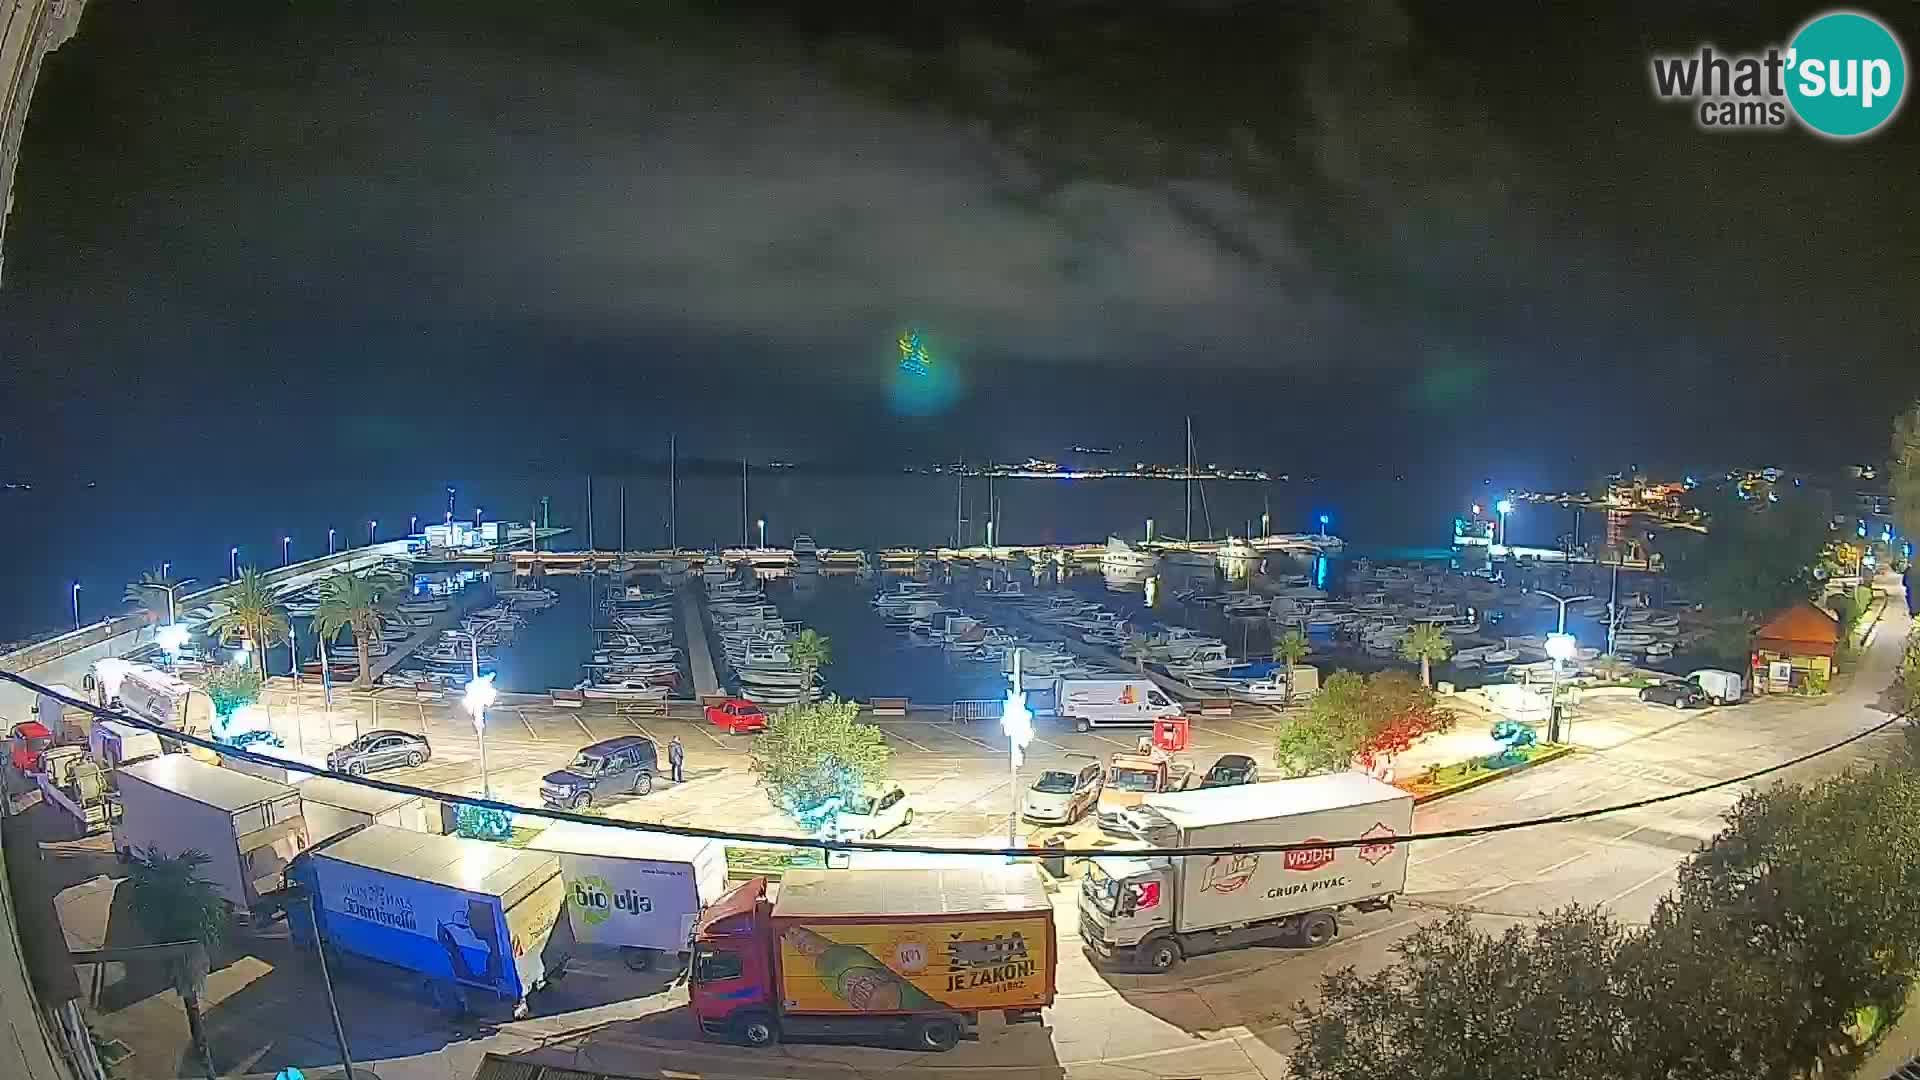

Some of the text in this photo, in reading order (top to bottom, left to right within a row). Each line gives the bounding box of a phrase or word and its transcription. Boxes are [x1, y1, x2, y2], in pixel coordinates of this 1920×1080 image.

[1287, 847, 1334, 866] VAJDA
[575, 883, 652, 915] bio ulja
[1267, 876, 1345, 898] GRUPA PIVAC
[945, 975, 968, 992] JE
[969, 959, 1035, 986] ZAKON!
